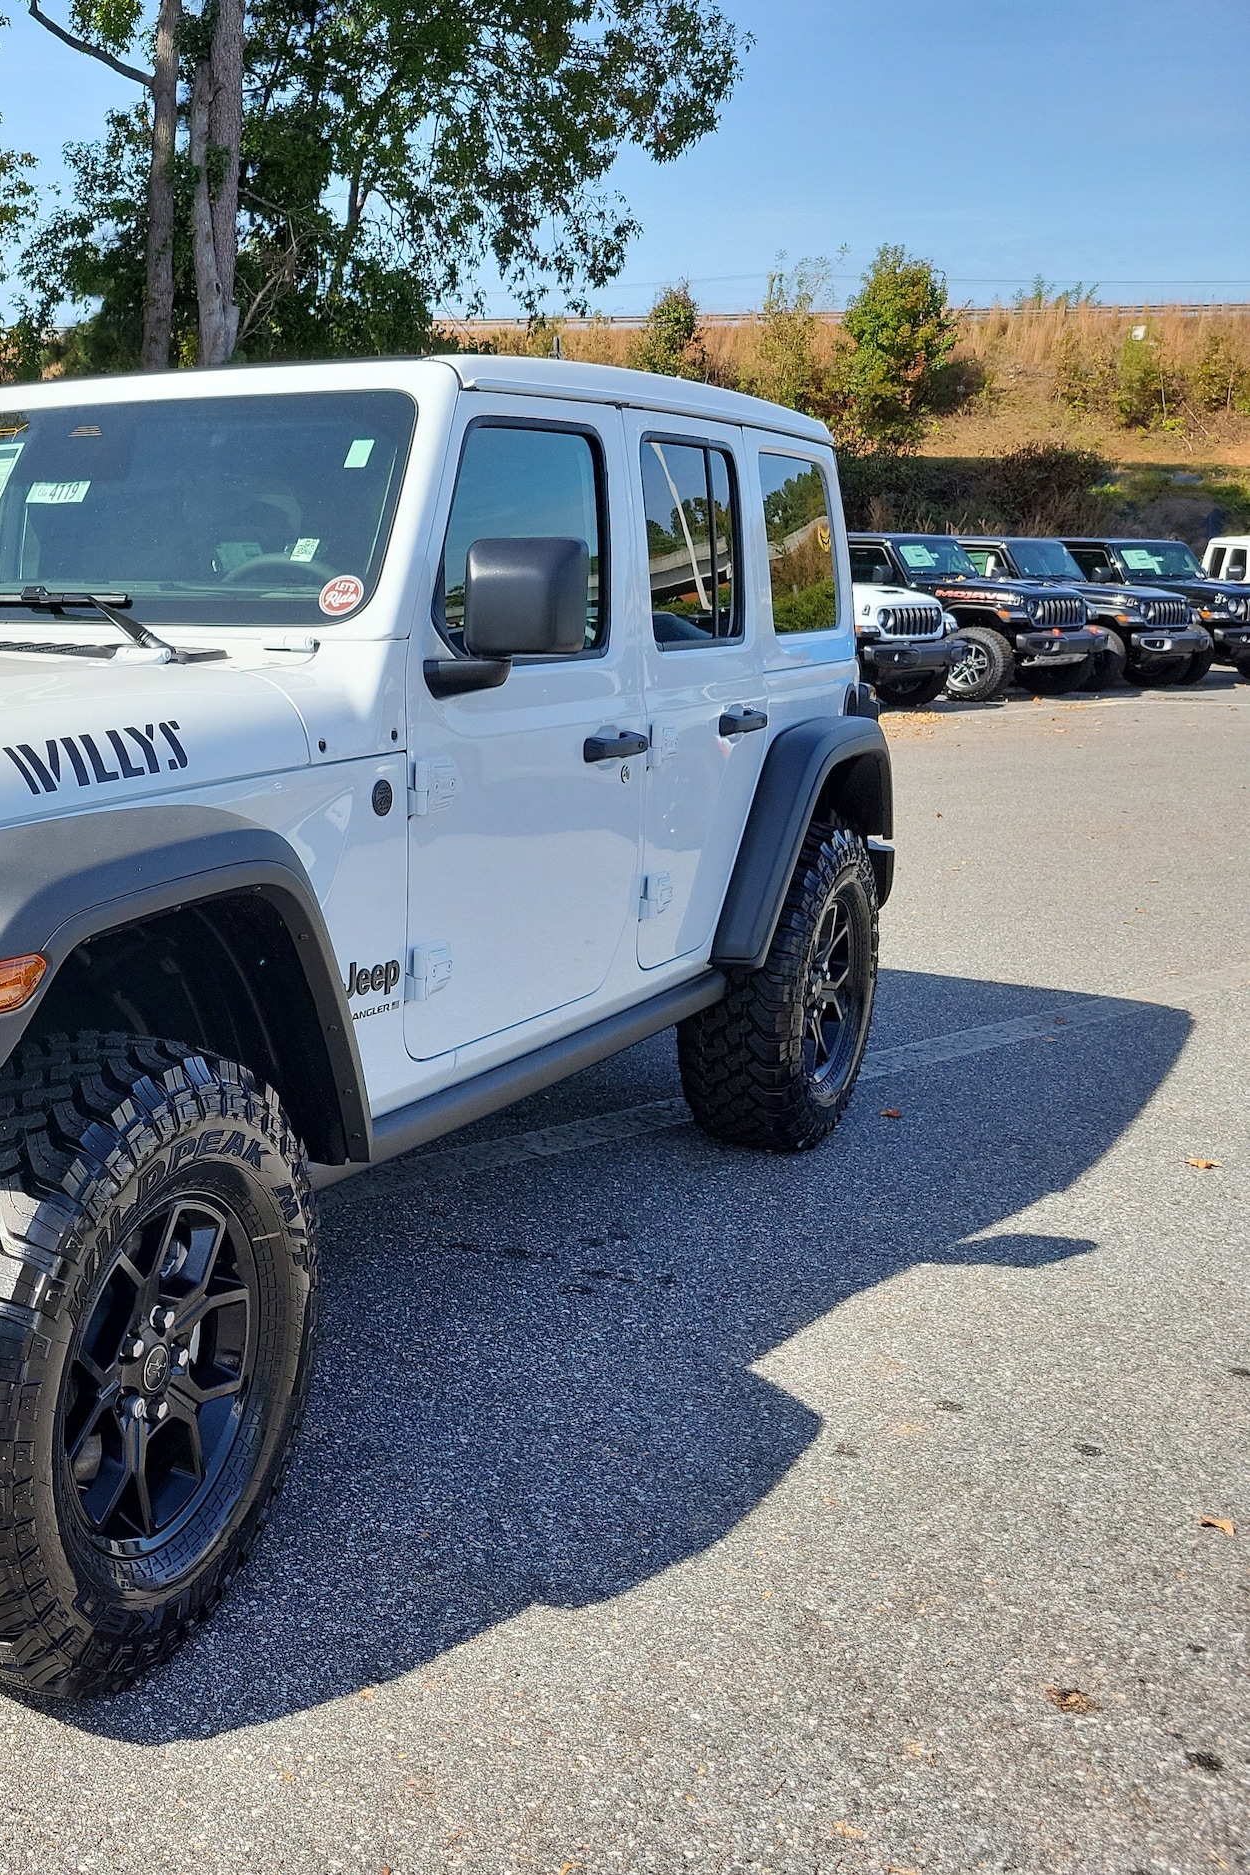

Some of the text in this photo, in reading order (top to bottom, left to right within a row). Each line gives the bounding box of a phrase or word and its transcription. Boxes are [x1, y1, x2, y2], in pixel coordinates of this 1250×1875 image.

[49, 482, 80, 501] 4119
[324, 590, 358, 608] Ride
[934, 588, 1010, 602] MOJAVE
[1, 720, 190, 796] WILLYS
[343, 959, 401, 1000] Jeep
[352, 1003, 390, 1021] ANGLER
